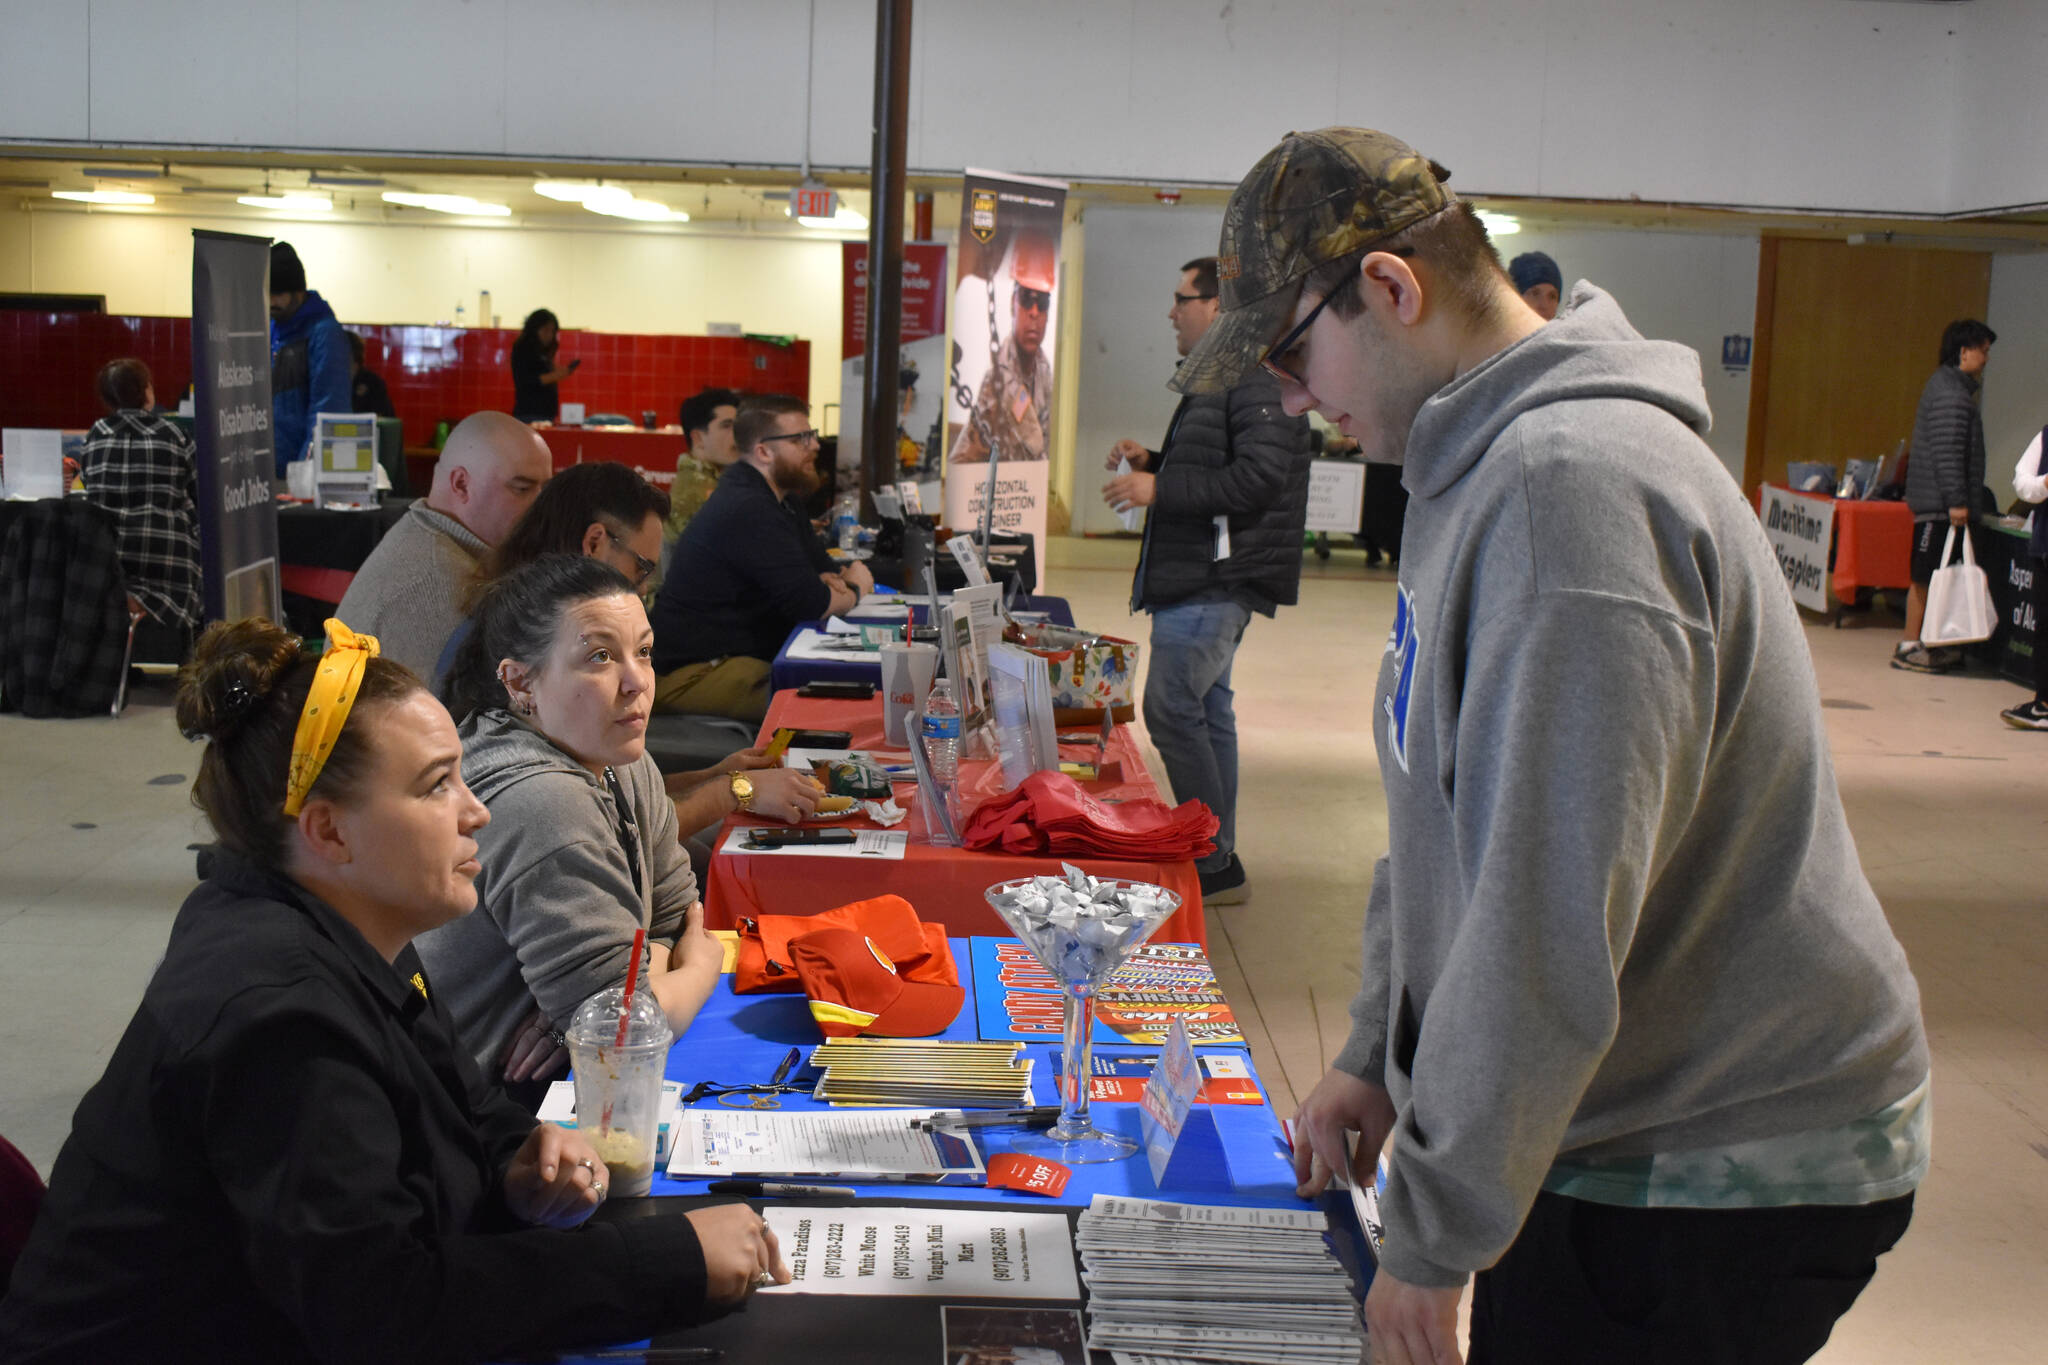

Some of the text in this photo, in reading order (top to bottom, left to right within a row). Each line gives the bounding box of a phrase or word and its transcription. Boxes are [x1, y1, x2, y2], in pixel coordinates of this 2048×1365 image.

[797, 190, 831, 217] EXIT
[217, 361, 254, 389] Alaskans
[218, 403, 269, 437] Disabilities
[223, 475, 271, 513] Good Jobs
[967, 496, 1035, 513] CONTRUCTION
[974, 480, 1029, 496] HOZONTAL
[978, 513, 1022, 529] EGINEER
[1767, 498, 1823, 544] Maritime
[1775, 545, 1822, 592] licopters
[994, 942, 1065, 1035] CANDY ATTACK!
[1096, 991, 1219, 1004] HERSHEY'S
[1032, 1163, 1053, 1181] OFF
[791, 1219, 812, 1281] Pizza Paradisos
[823, 1223, 846, 1279] (907)283-2222
[857, 1226, 878, 1277] White Moose
[892, 1224, 915, 1280] (907)395-0419
[927, 1225, 949, 1281] Vaughn's Mini
[958, 1243, 975, 1262] Mart
[990, 1227, 1015, 1281] (907)262-6893
